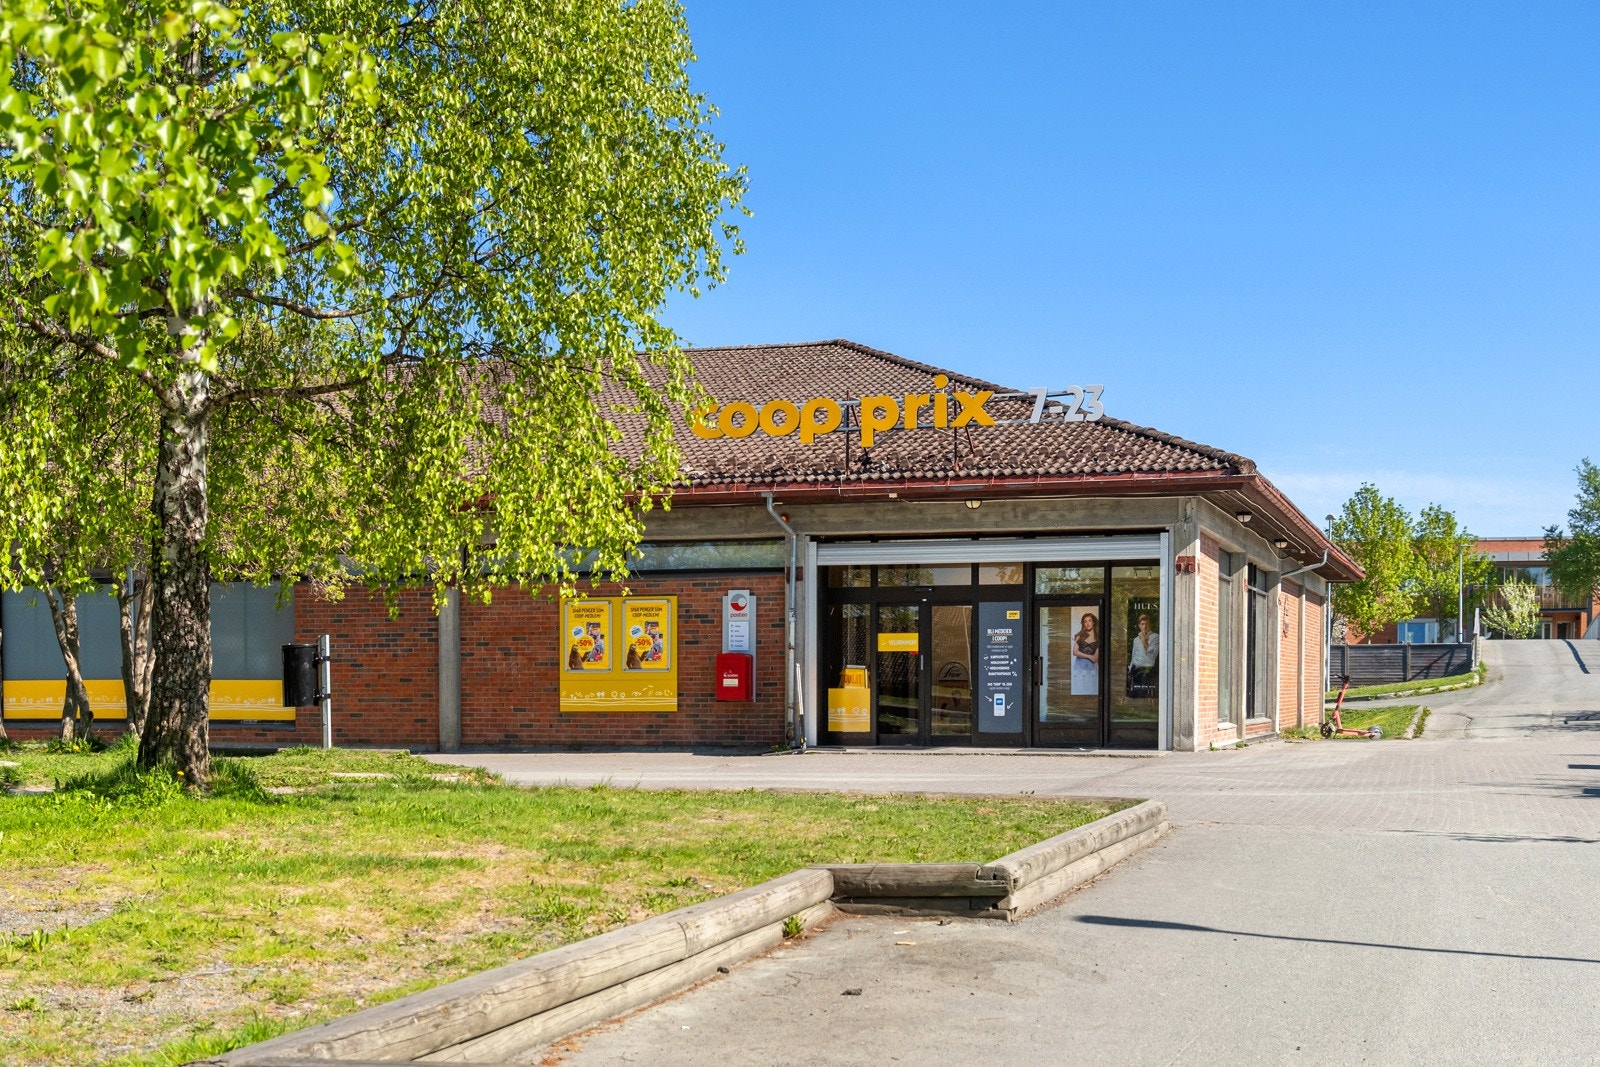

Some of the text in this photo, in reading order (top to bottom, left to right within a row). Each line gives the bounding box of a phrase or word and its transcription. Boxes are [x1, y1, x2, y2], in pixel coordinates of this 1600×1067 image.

[691, 374, 996, 447] coop prix
[1027, 384, 1105, 424] 7-23
